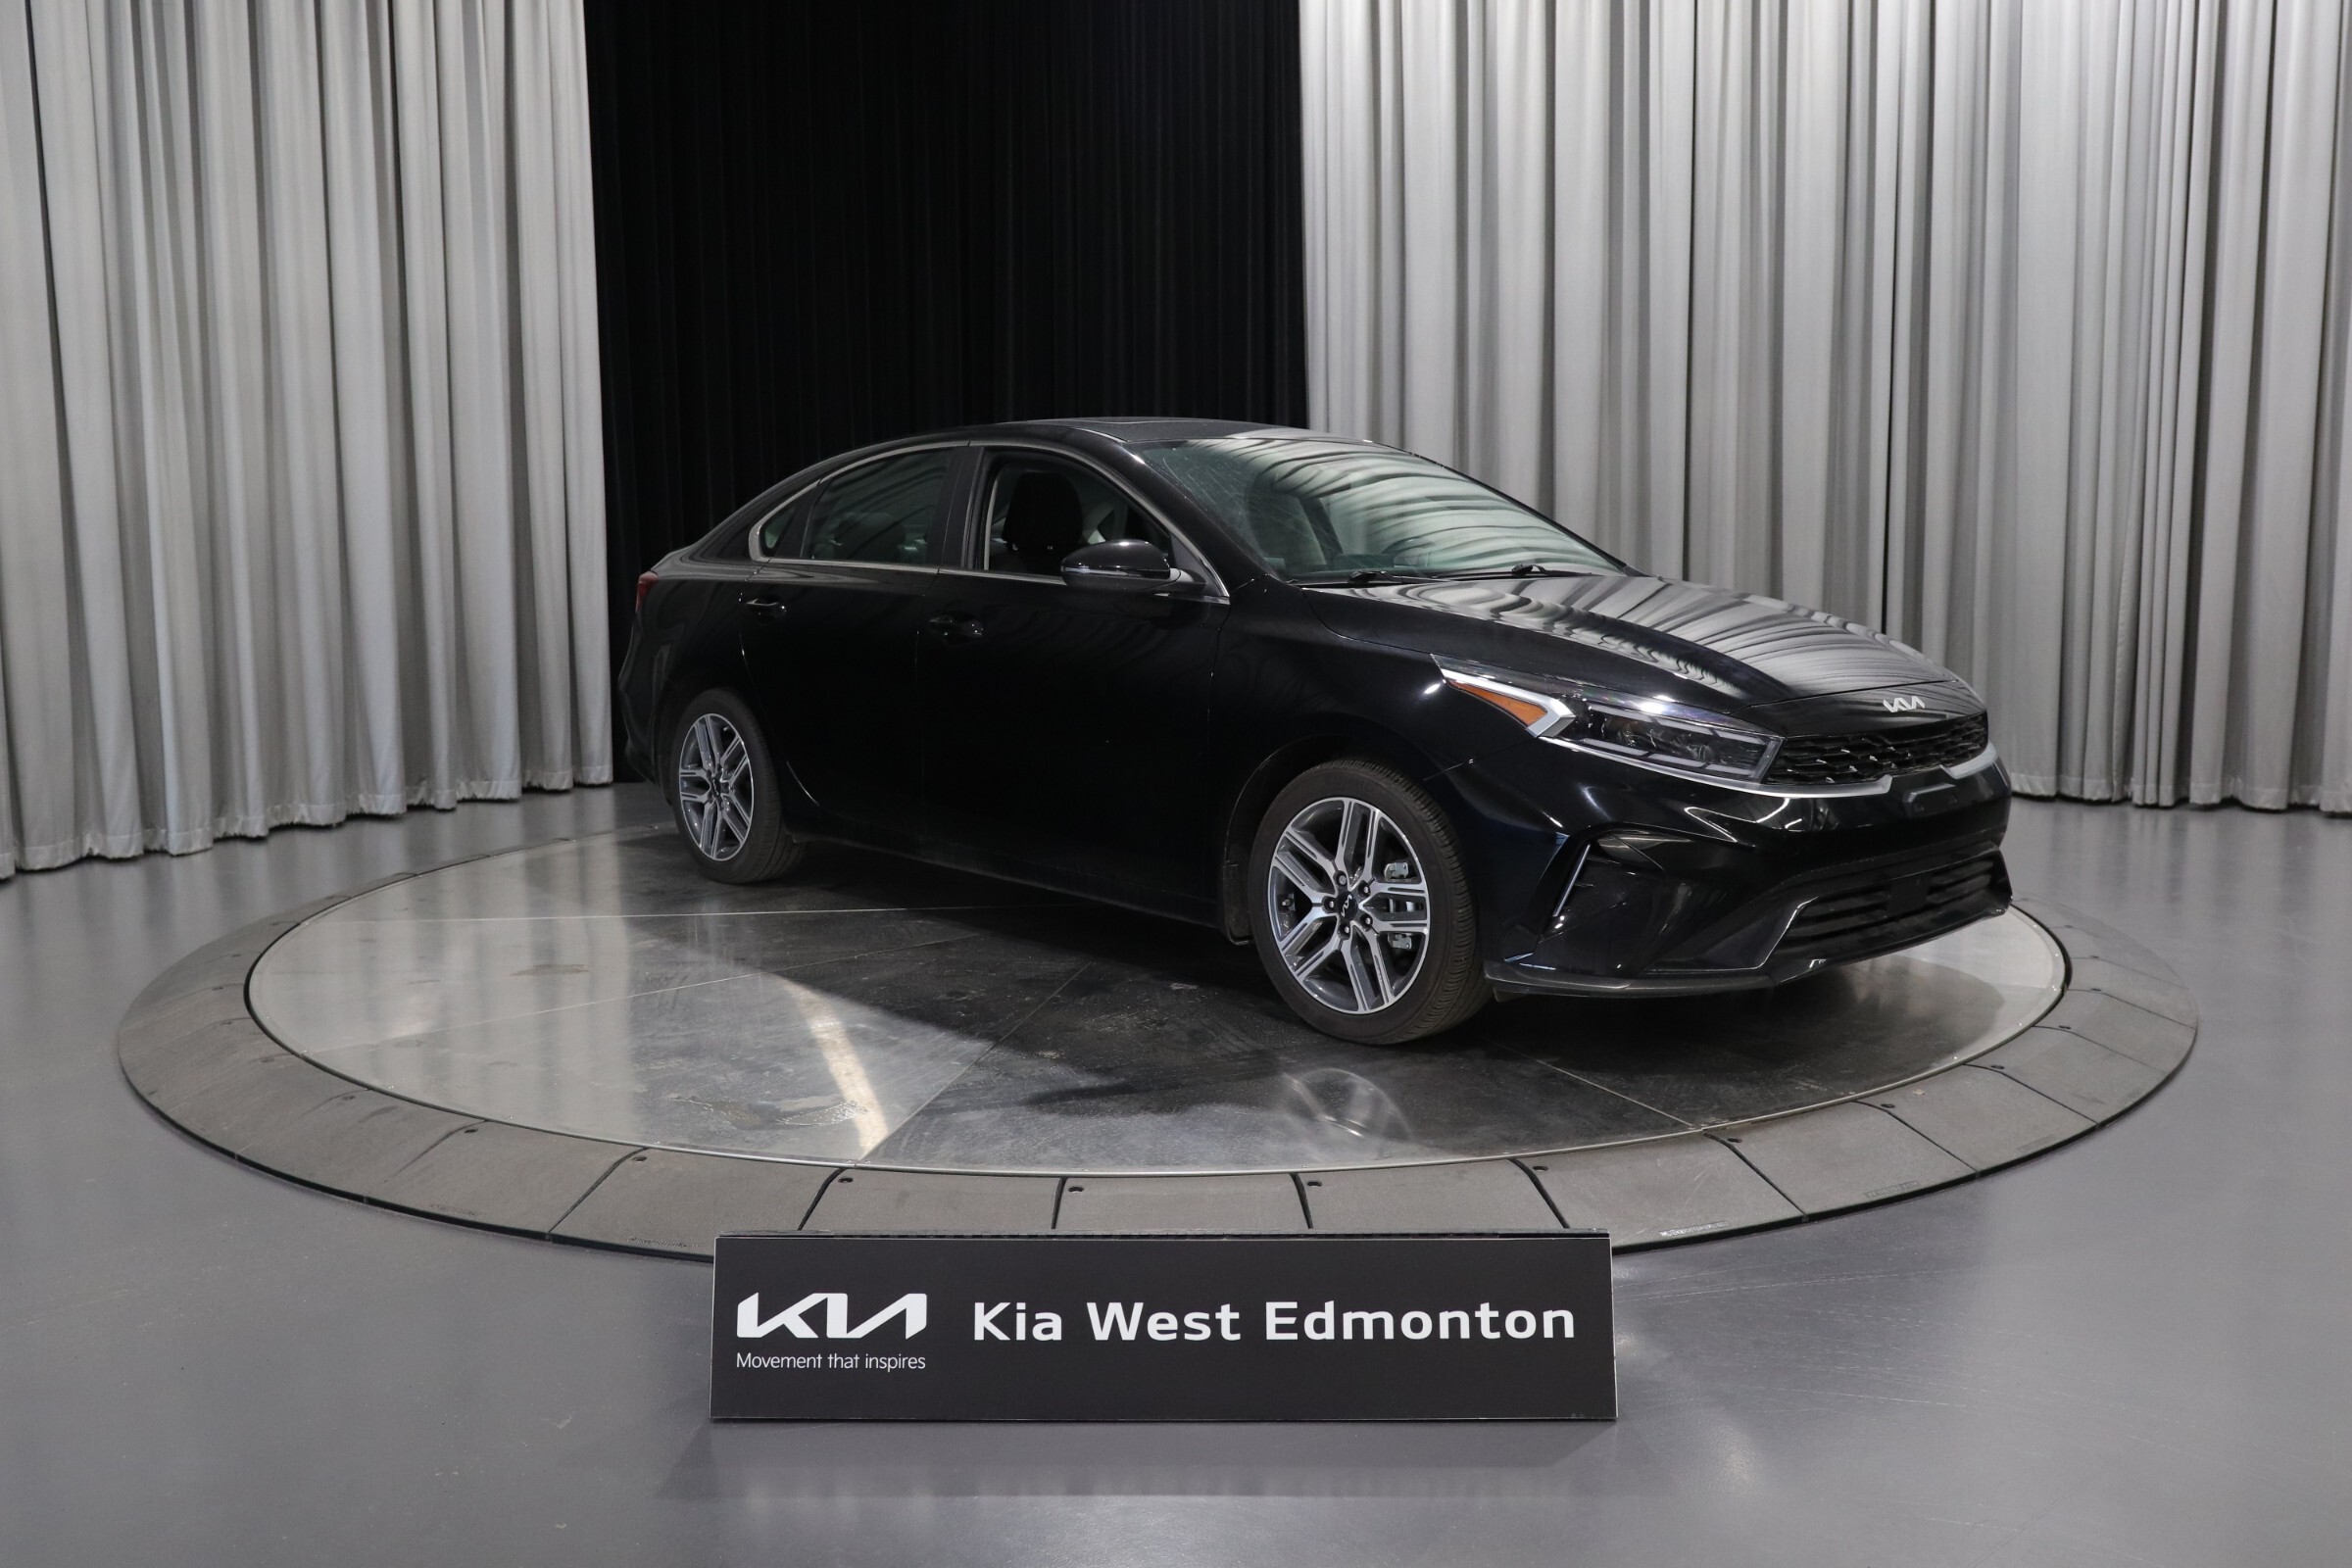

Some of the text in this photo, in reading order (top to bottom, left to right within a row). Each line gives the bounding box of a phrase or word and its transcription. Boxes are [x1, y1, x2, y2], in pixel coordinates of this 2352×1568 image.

[1883, 696, 1926, 712] KIA
[737, 1293, 927, 1339] KIA
[974, 1299, 1575, 1342] Kia West Edmonton
[737, 1352, 926, 1373] Movement that inspires
